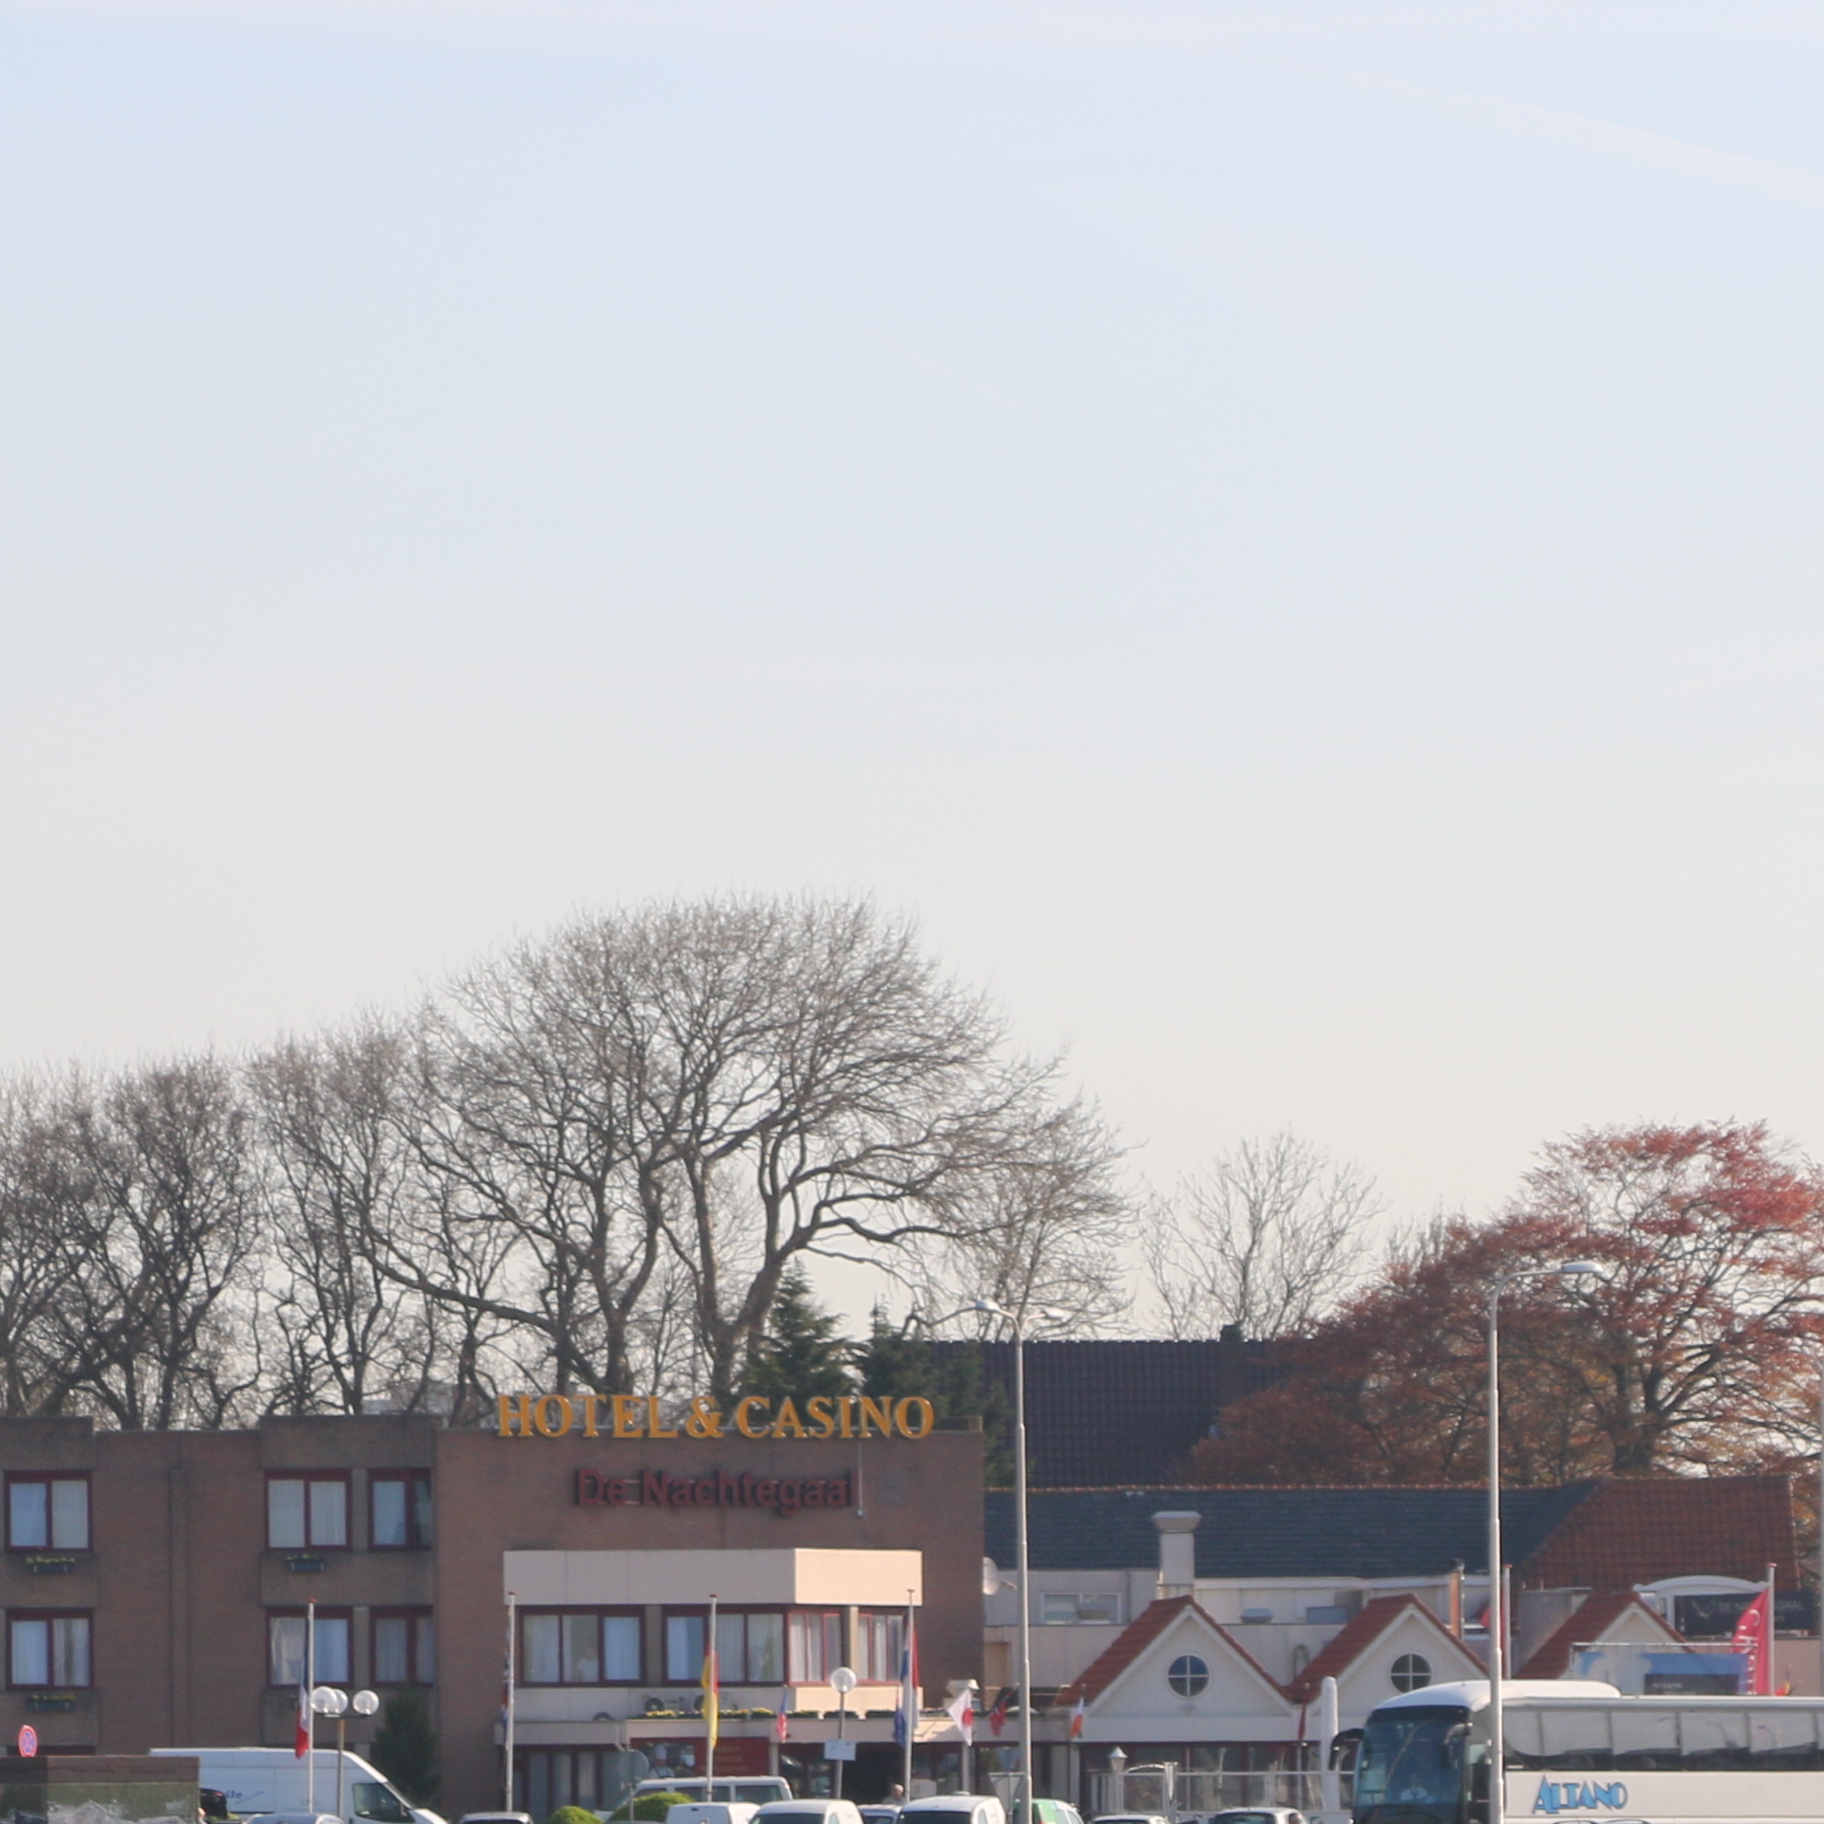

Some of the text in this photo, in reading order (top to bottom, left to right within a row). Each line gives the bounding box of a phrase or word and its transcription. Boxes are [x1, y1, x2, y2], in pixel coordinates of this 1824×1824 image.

[496, 1394, 936, 1440] HOTEL & CASINO
[575, 1467, 863, 1516] De Nachtegaal
[1531, 1774, 1629, 1815] ALTANO
